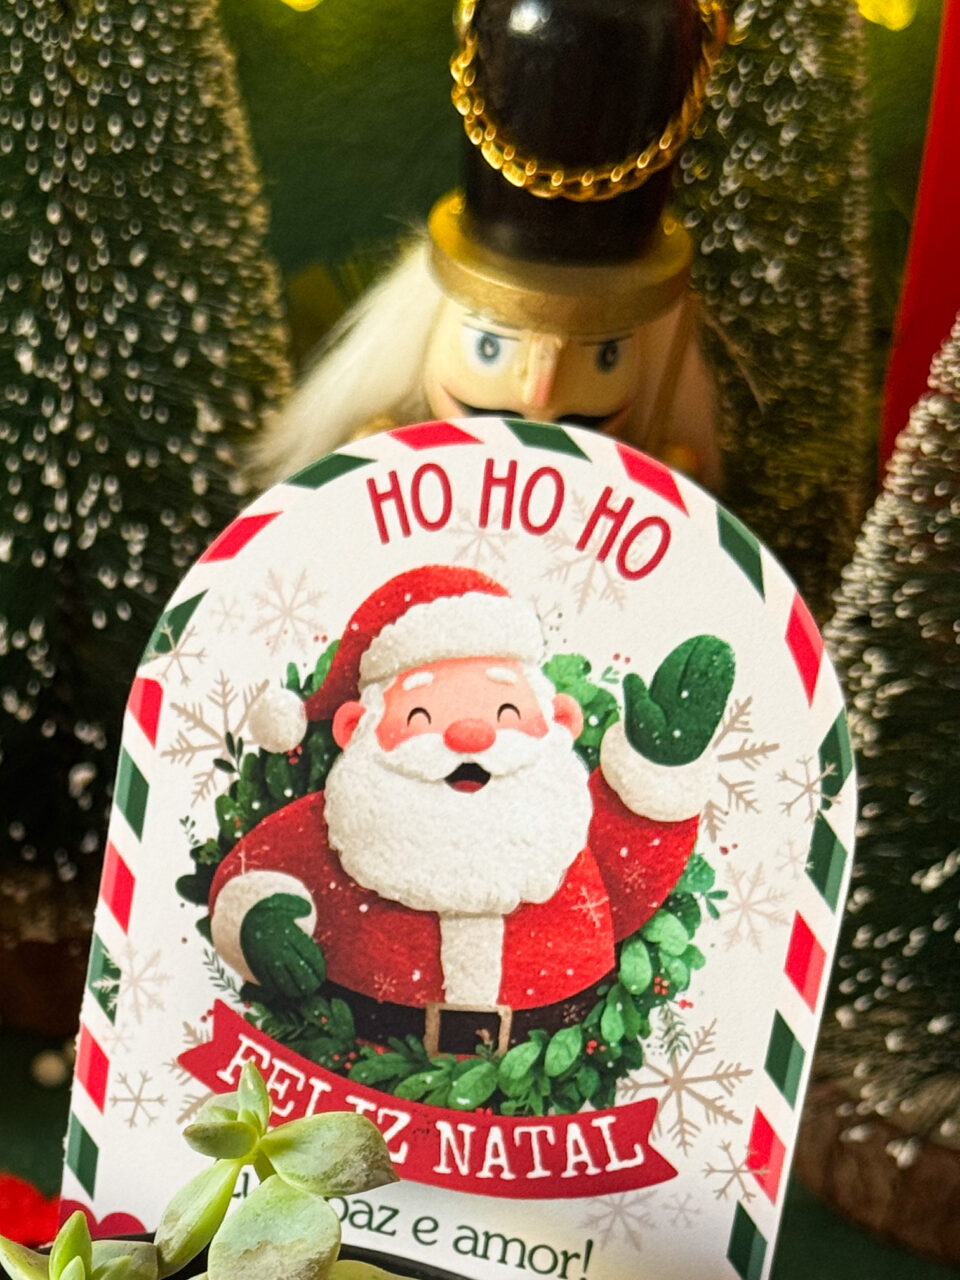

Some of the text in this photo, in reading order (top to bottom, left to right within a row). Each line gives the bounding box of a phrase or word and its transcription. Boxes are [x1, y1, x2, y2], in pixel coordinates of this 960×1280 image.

[366, 458, 671, 581] HO HO HO
[432, 1115, 645, 1180] NATAL
[412, 1216, 439, 1246] e
